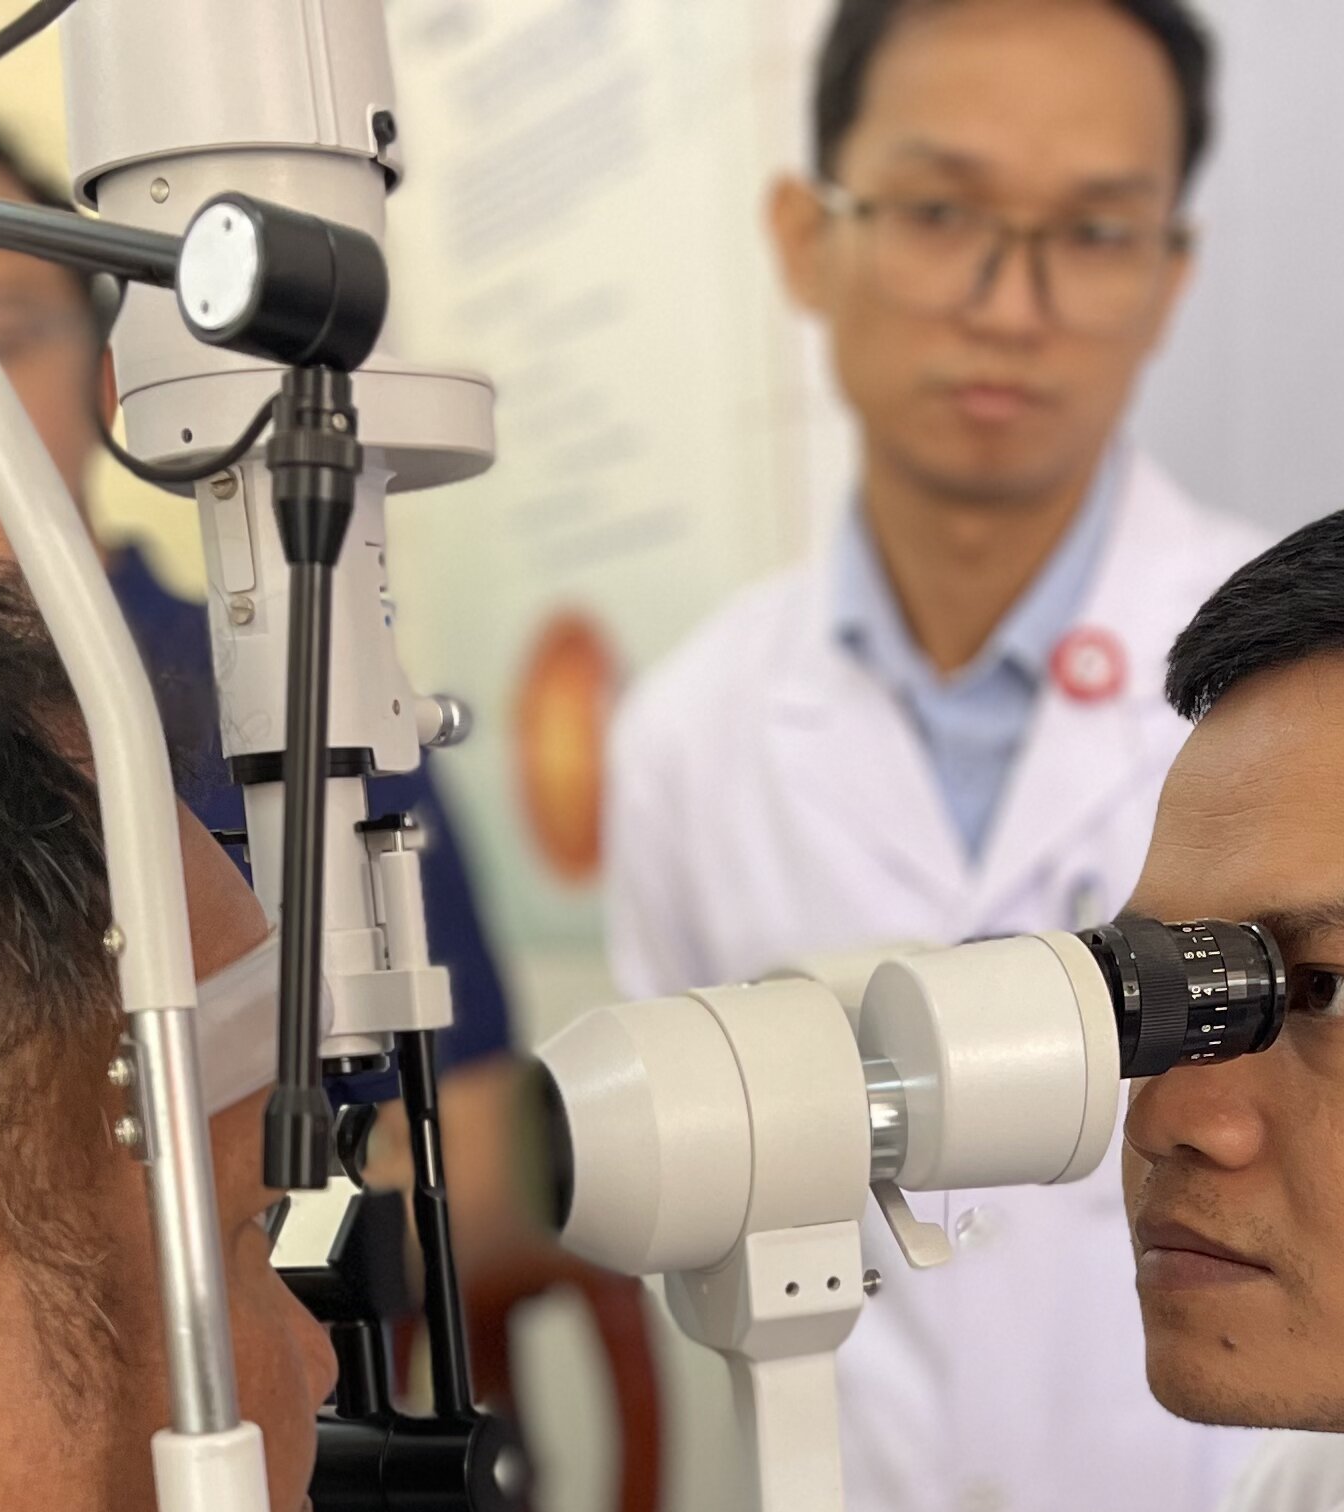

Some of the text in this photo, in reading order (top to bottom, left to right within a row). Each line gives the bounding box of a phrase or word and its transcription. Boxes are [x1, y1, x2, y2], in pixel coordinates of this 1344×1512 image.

[1184, 950, 1207, 960] 5 2
[1191, 985, 1213, 1000] 10 4
